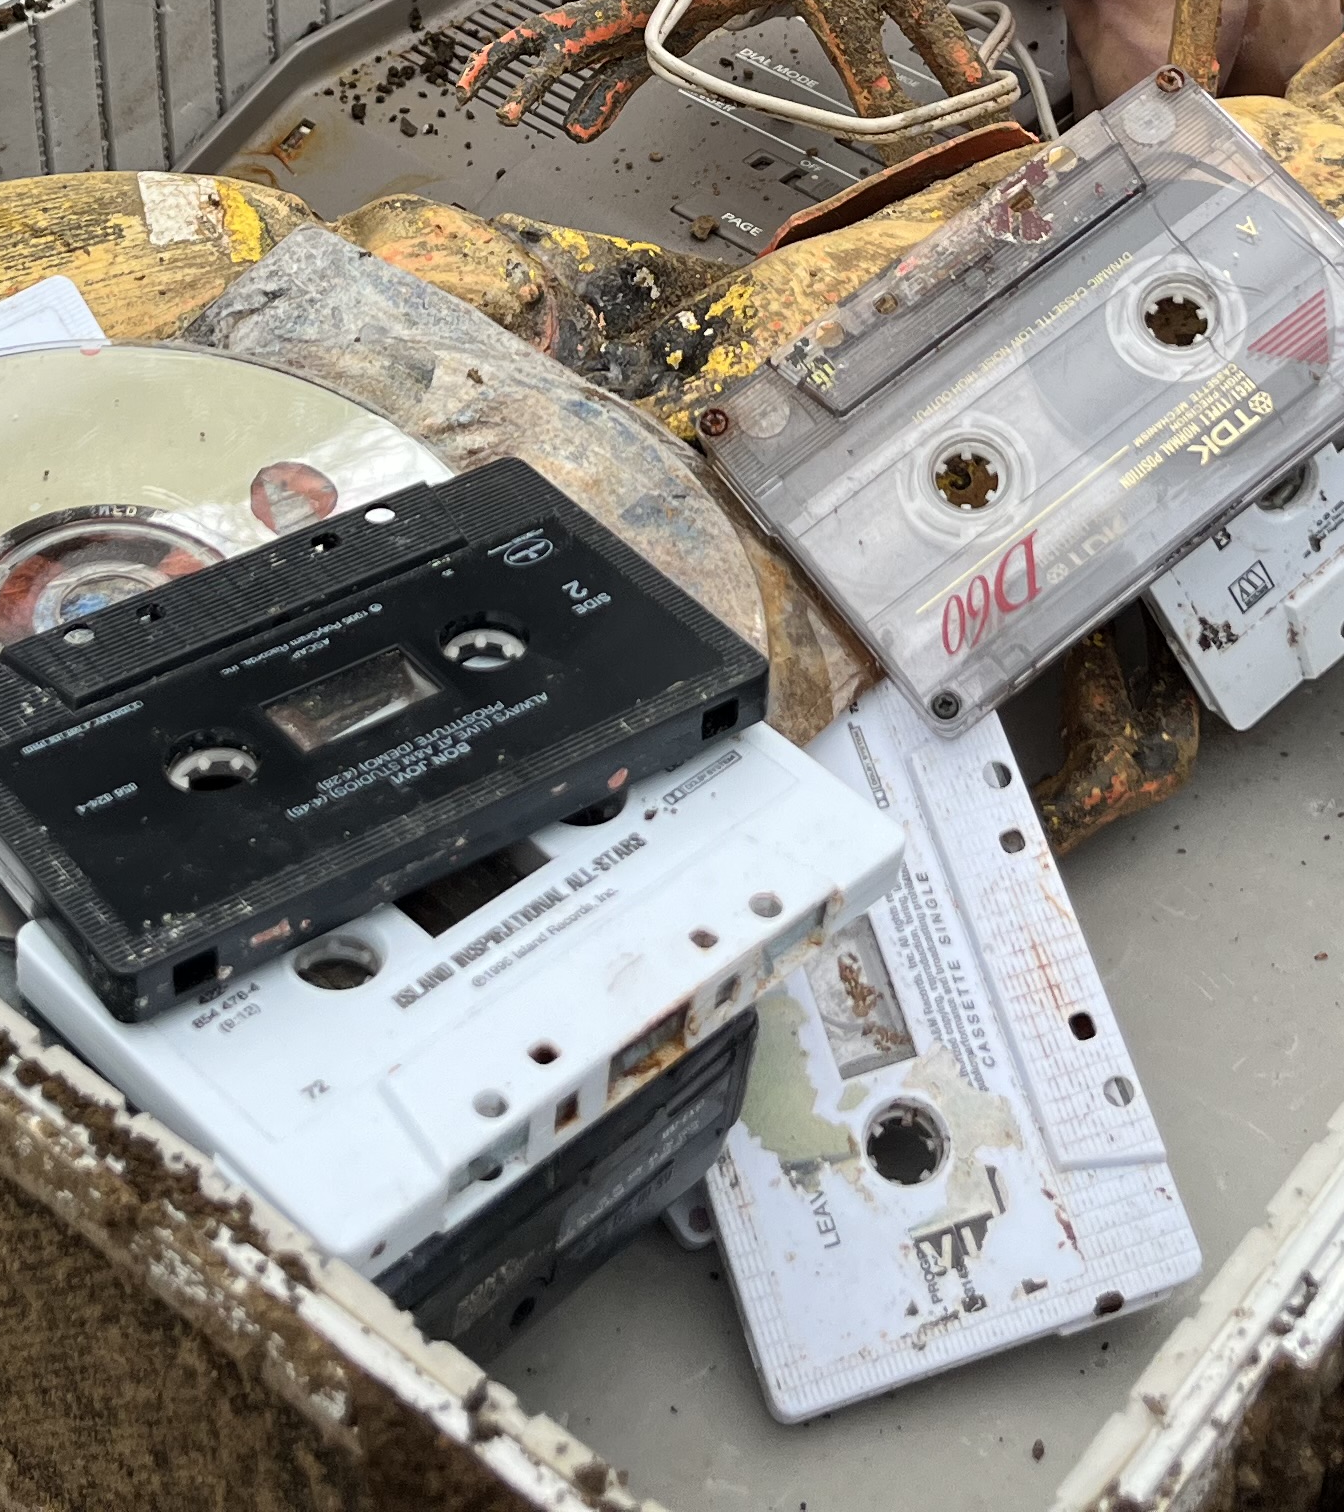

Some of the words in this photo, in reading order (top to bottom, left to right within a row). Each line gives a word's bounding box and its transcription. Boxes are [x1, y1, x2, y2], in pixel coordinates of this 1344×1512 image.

[738, 47, 771, 67] DIAL
[773, 64, 819, 88] MODE
[798, 158, 824, 173] OFF
[721, 212, 763, 237] PAGE
[1233, 215, 1263, 239] A
[1085, 250, 1133, 289] DYNAMIC
[1033, 284, 1088, 329] CASSETTE
[1008, 325, 1036, 348] LOW
[976, 343, 1012, 373] NOISE
[949, 369, 978, 394] HIGH
[1187, 361, 1239, 403] CASSETTE
[1218, 369, 1246, 392] HIGH
[909, 388, 953, 425] OUTPUT
[1167, 389, 1221, 432] PRECISION
[1130, 400, 1190, 448] MECHANISM
[1157, 420, 1202, 458] NORMAL
[1184, 403, 1263, 466] TDK
[1116, 450, 1165, 490] POSITION
[558, 577, 592, 602] 2
[569, 590, 613, 616] SIDE
[940, 530, 1041, 656] D60
[286, 618, 343, 648] PolyGram
[288, 636, 332, 659] ASCAP
[412, 698, 505, 746] PROSTITUTE
[490, 690, 550, 724] ALWAYS
[431, 733, 456, 751] AT
[452, 716, 493, 741] (LIVE
[356, 739, 414, 772] (DEMO)
[398, 742, 436, 766] A&M
[429, 739, 473, 766] BON
[326, 758, 401, 799] STUDIOS)
[387, 758, 432, 785] JOVI
[389, 959, 455, 1010] ISLAND
[450, 879, 571, 970] INSPIRATIONAL
[564, 827, 648, 895] ALL-STARS
[510, 929, 548, 961] Island
[593, 880, 619, 906] Inc.
[886, 903, 907, 935] rights
[913, 869, 952, 948] SINGLE
[897, 933, 911, 950] All
[913, 910, 946, 976] broadcasting
[907, 925, 939, 993] reproduction,
[910, 969, 935, 1017] Records,
[937, 974, 953, 997] and
[931, 991, 956, 1037] copying,
[944, 955, 998, 1072] CASSETTE
[301, 1078, 331, 1100] 72
